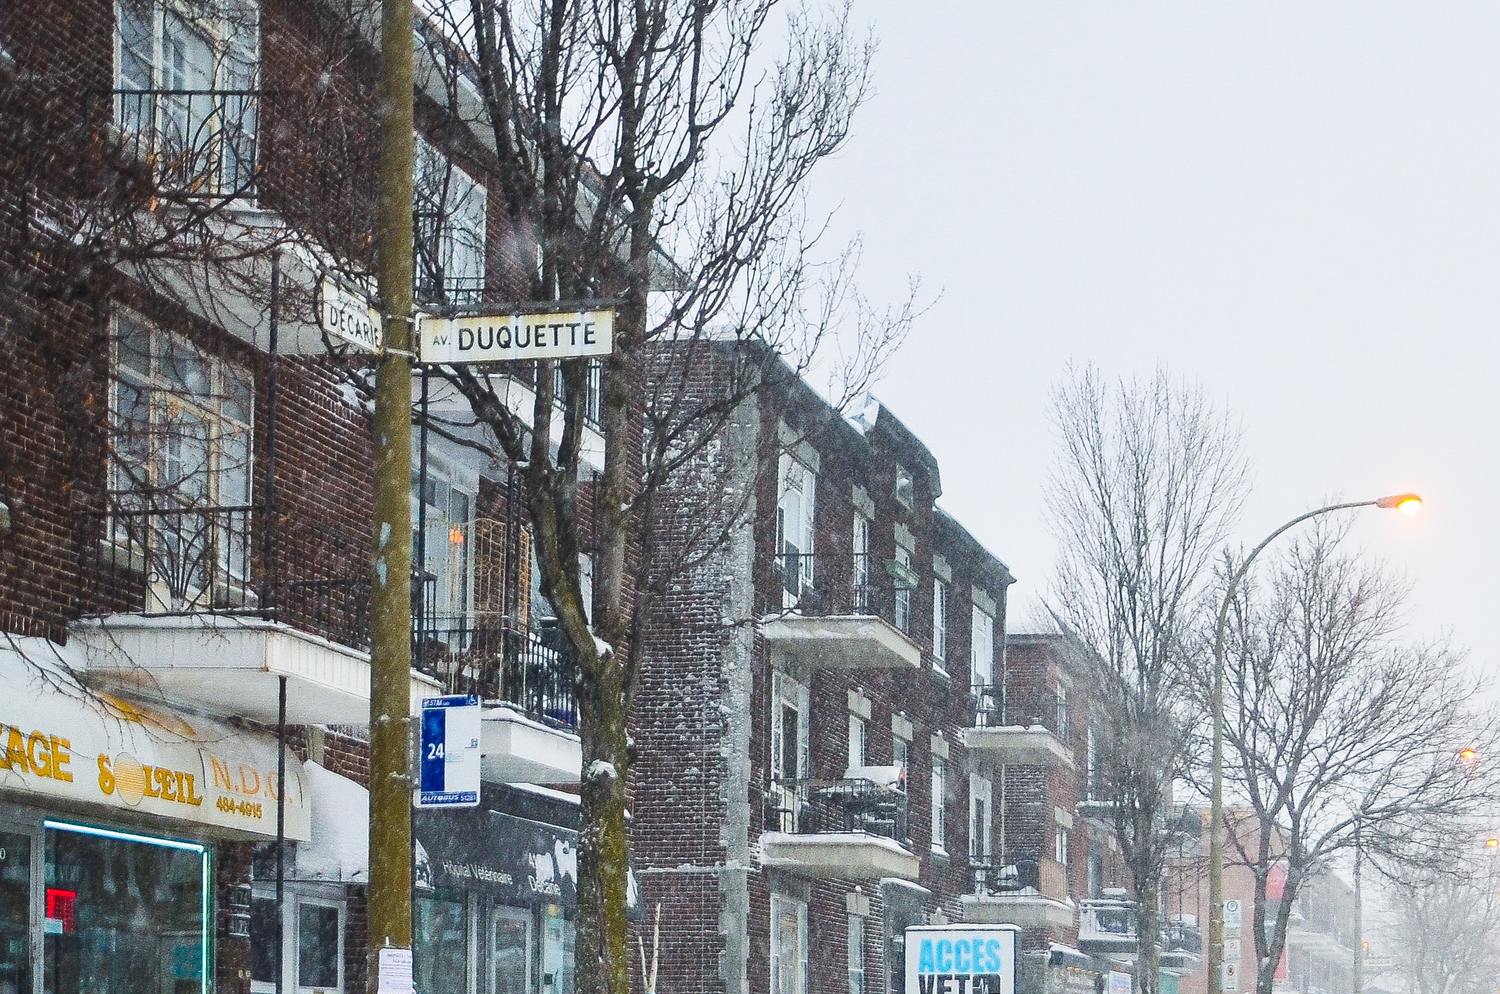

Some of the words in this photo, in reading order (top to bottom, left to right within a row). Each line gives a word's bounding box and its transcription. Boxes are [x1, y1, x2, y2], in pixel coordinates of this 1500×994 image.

[433, 335, 450, 346] AV.
[458, 322, 596, 351] DUQUETTE
[427, 742, 444, 760] 24
[918, 938, 1001, 973] ACCES
